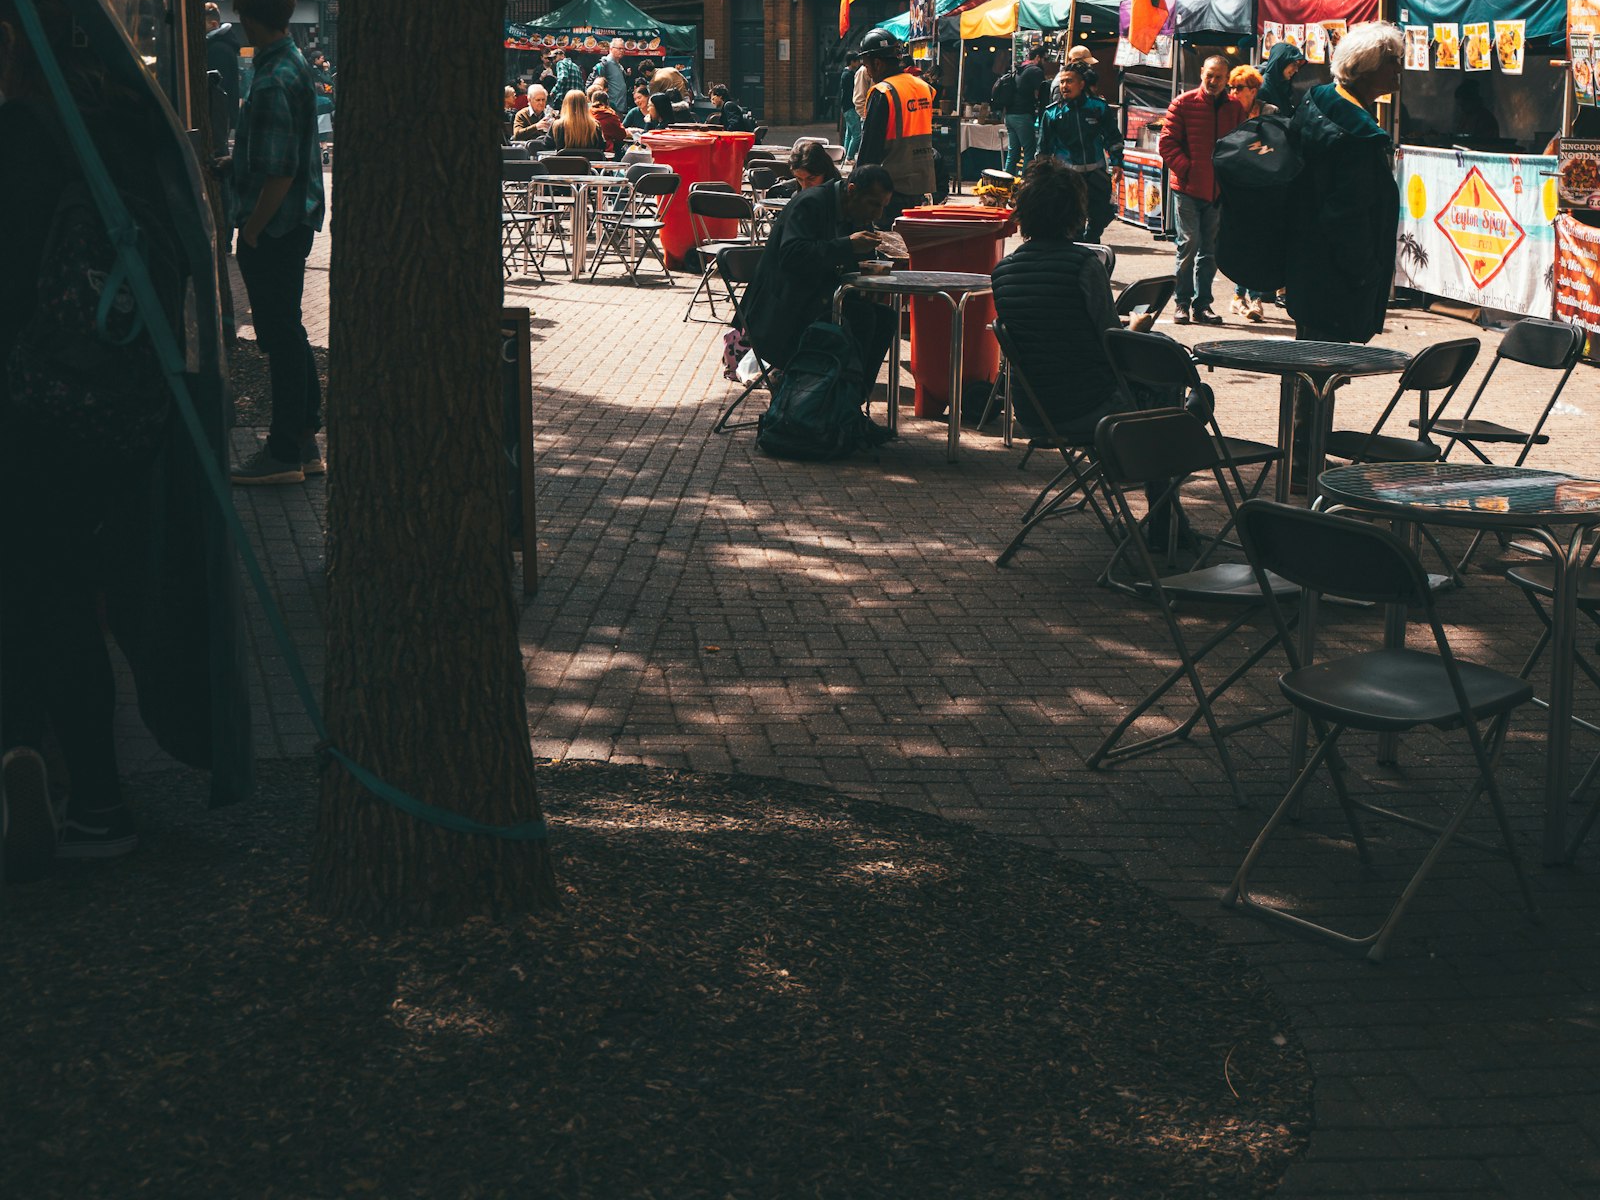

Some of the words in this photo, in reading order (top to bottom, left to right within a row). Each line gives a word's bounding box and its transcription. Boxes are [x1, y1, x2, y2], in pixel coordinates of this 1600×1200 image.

[1561, 143, 1600, 151] SINGAPOR
[1561, 151, 1600, 160] NOODLE
[1451, 206, 1479, 230] Ceylon
[1482, 210, 1507, 237] Spicy
